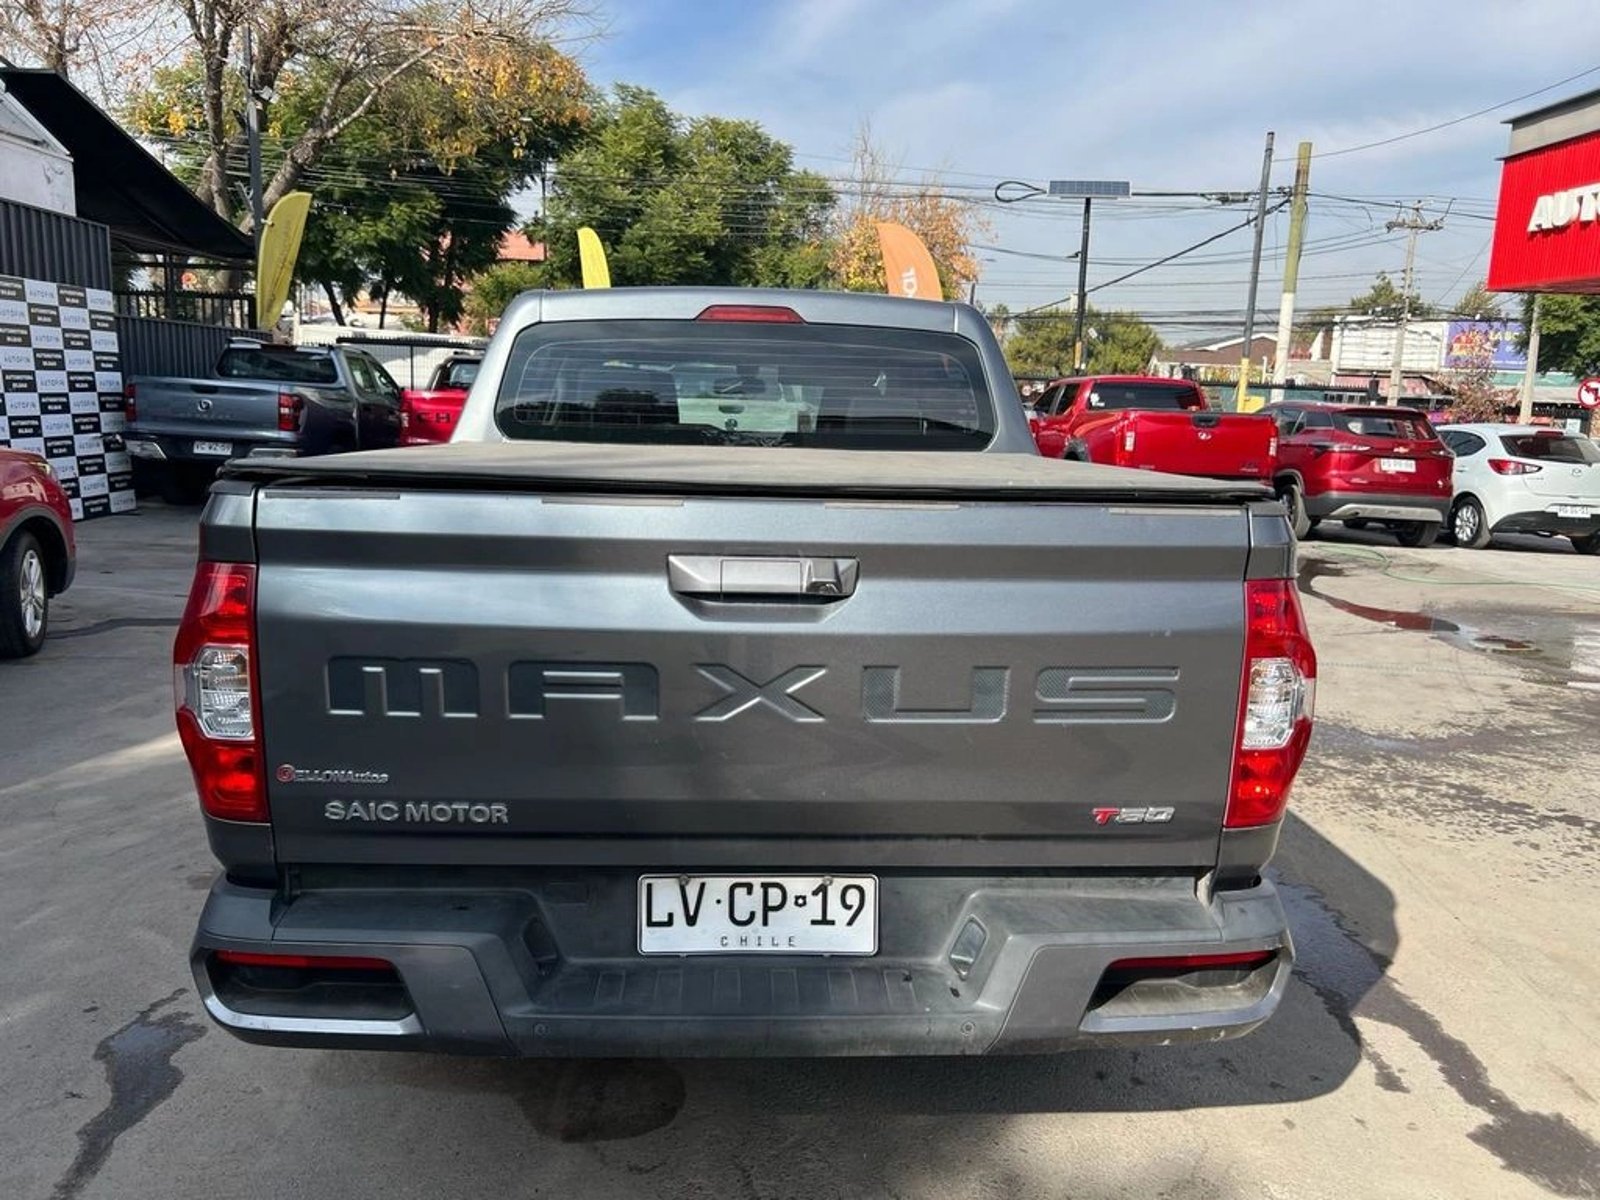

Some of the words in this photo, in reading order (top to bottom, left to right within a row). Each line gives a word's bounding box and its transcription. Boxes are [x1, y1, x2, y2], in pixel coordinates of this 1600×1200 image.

[1527, 182, 1600, 232] AUT
[325, 655, 1181, 725] MAXUS
[324, 800, 400, 821] SAIC
[405, 802, 510, 824] MOTOR
[1092, 806, 1176, 826] T60
[719, 935, 797, 948] CHILE
